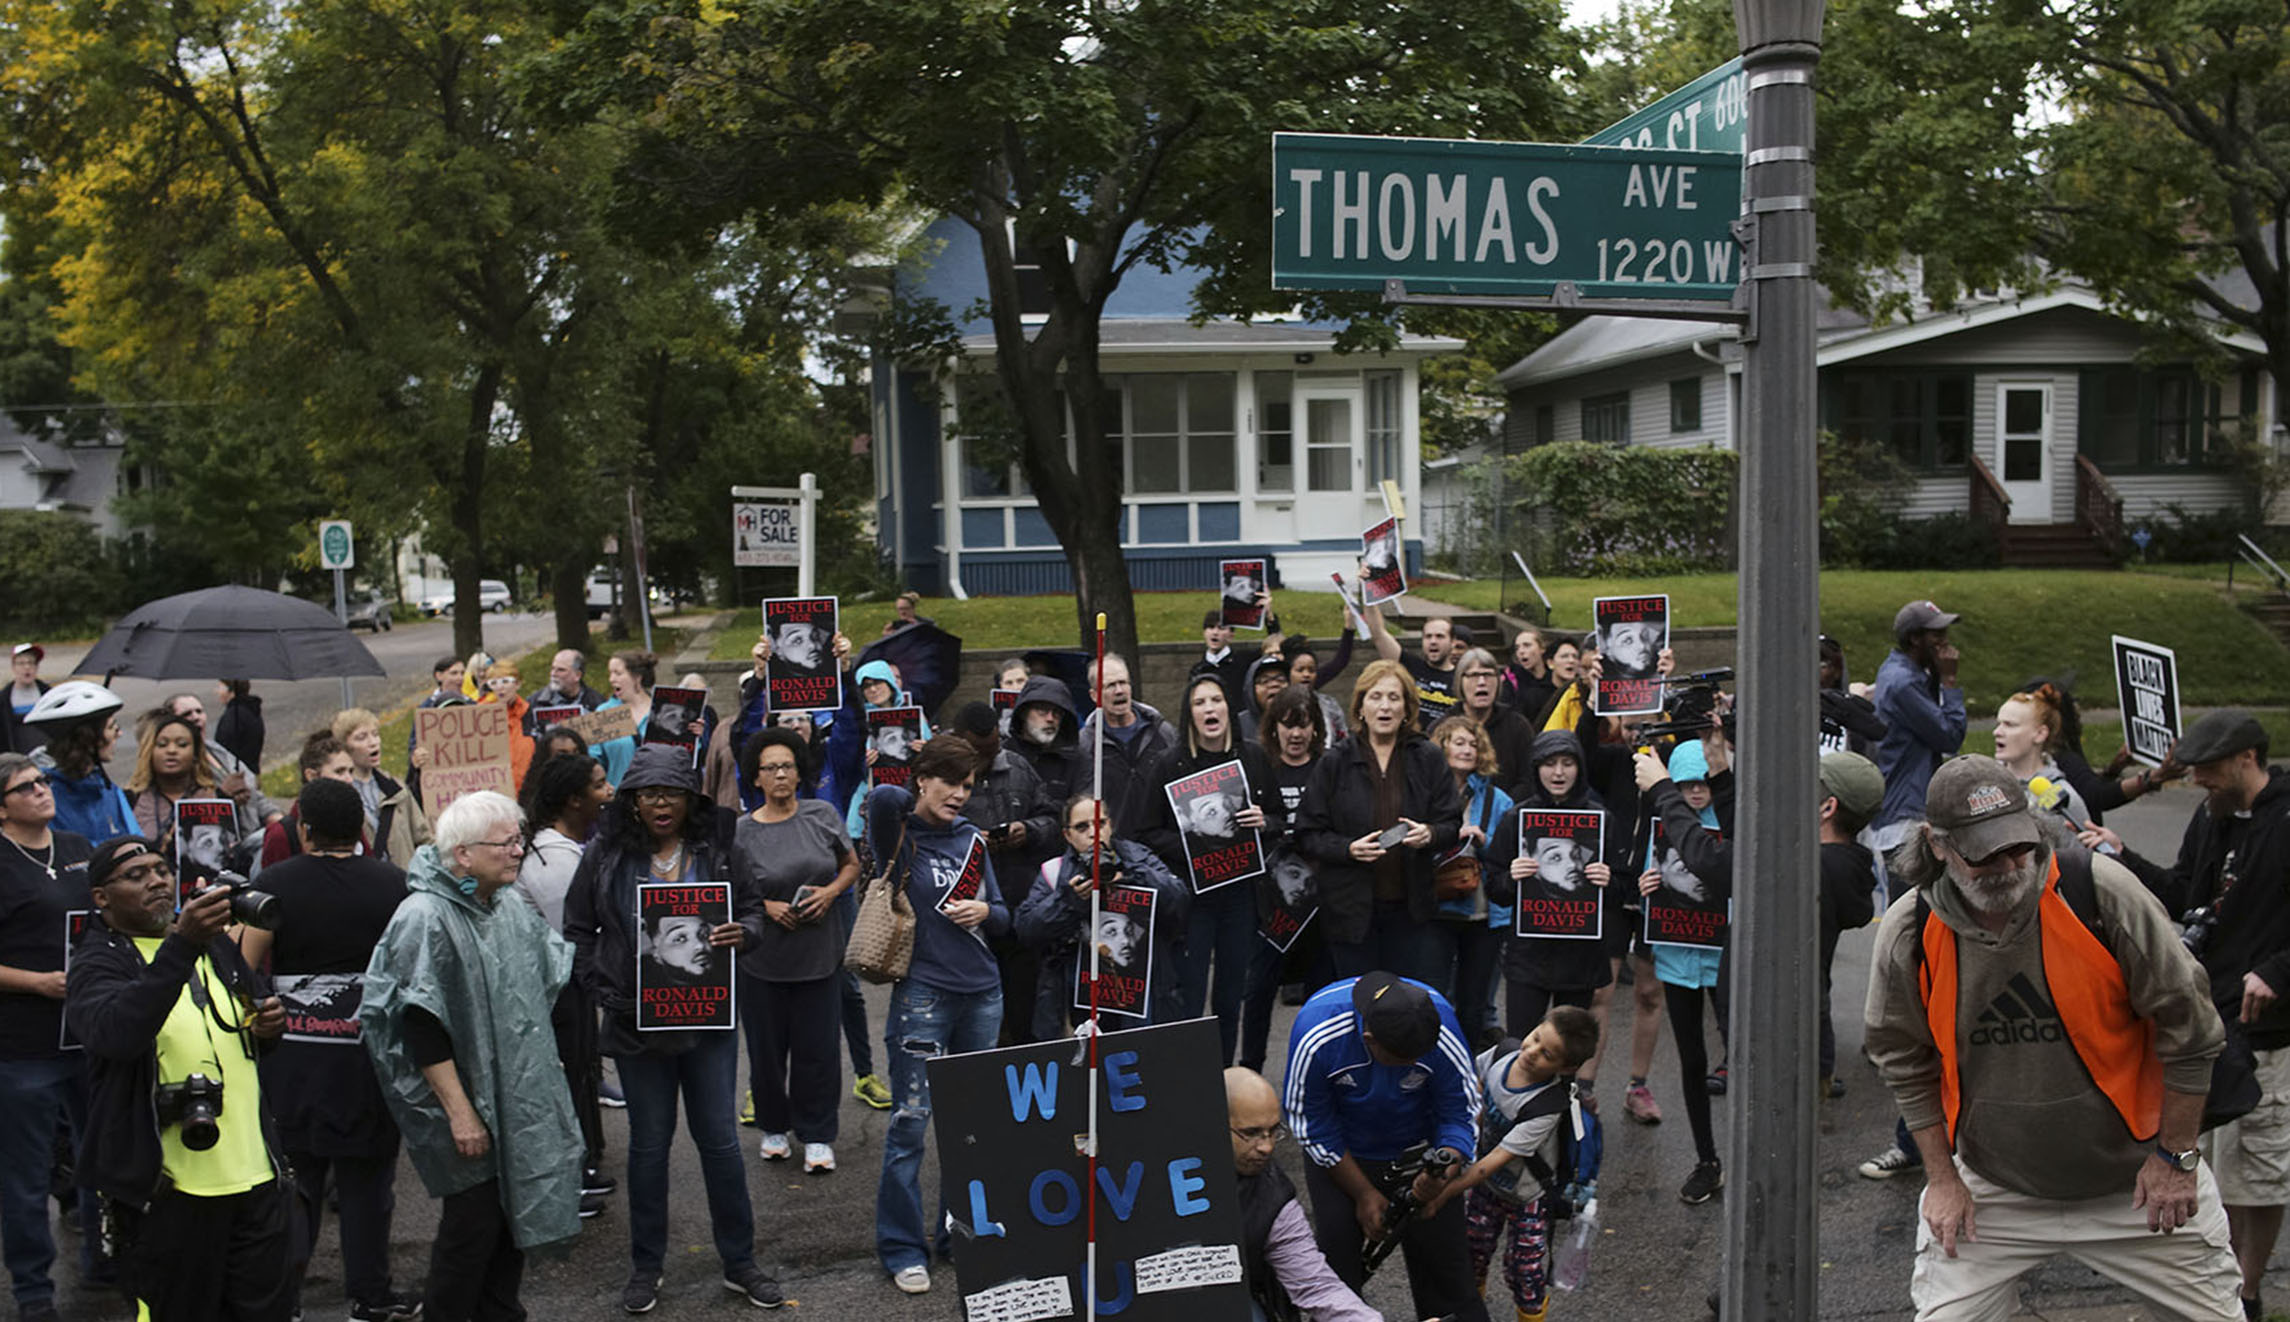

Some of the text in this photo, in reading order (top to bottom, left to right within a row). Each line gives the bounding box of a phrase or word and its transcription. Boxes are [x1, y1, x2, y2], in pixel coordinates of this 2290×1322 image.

[1623, 164, 1698, 210] AVE
[1290, 169, 1560, 265] THOMAS
[1598, 238, 1733, 284] 1220 W
[761, 508, 791, 525] FOR
[761, 526, 797, 543] SALE
[769, 601, 832, 616] JUSTICE
[1601, 600, 1663, 615] JUSTICE
[2128, 653, 2164, 690] BLACK
[771, 677, 835, 691] RONALD
[781, 689, 827, 702] DAVIS
[1609, 692, 1652, 705] DAVIS
[2135, 688, 2166, 725] LIVES
[420, 708, 505, 741] POLICE
[872, 710, 918, 723] JUSTICE
[434, 740, 498, 766] KILL
[422, 766, 507, 790] COMMUNITY
[1171, 765, 1239, 799] JUSTICE
[1526, 814, 1598, 829] JUSTICE
[1549, 827, 1573, 837] FOR
[1193, 841, 1256, 870] RONALD
[949, 841, 983, 901] USTICE
[1204, 856, 1249, 880] DAVIS
[643, 888, 725, 908] JUSTICE
[1523, 899, 1597, 914] RONALD
[672, 904, 700, 915] FOR
[1651, 907, 1726, 926] RONALD
[1533, 913, 1585, 927] DAVIS
[1662, 922, 1715, 937] DAVIS
[642, 986, 728, 1003] RONALD
[655, 1002, 716, 1018] DAVIS
[1969, 1019, 2061, 1045] adida
[1005, 1051, 1147, 1122] WE
[969, 1157, 1211, 1237] LOVE
[1080, 1261, 1134, 1315] U
